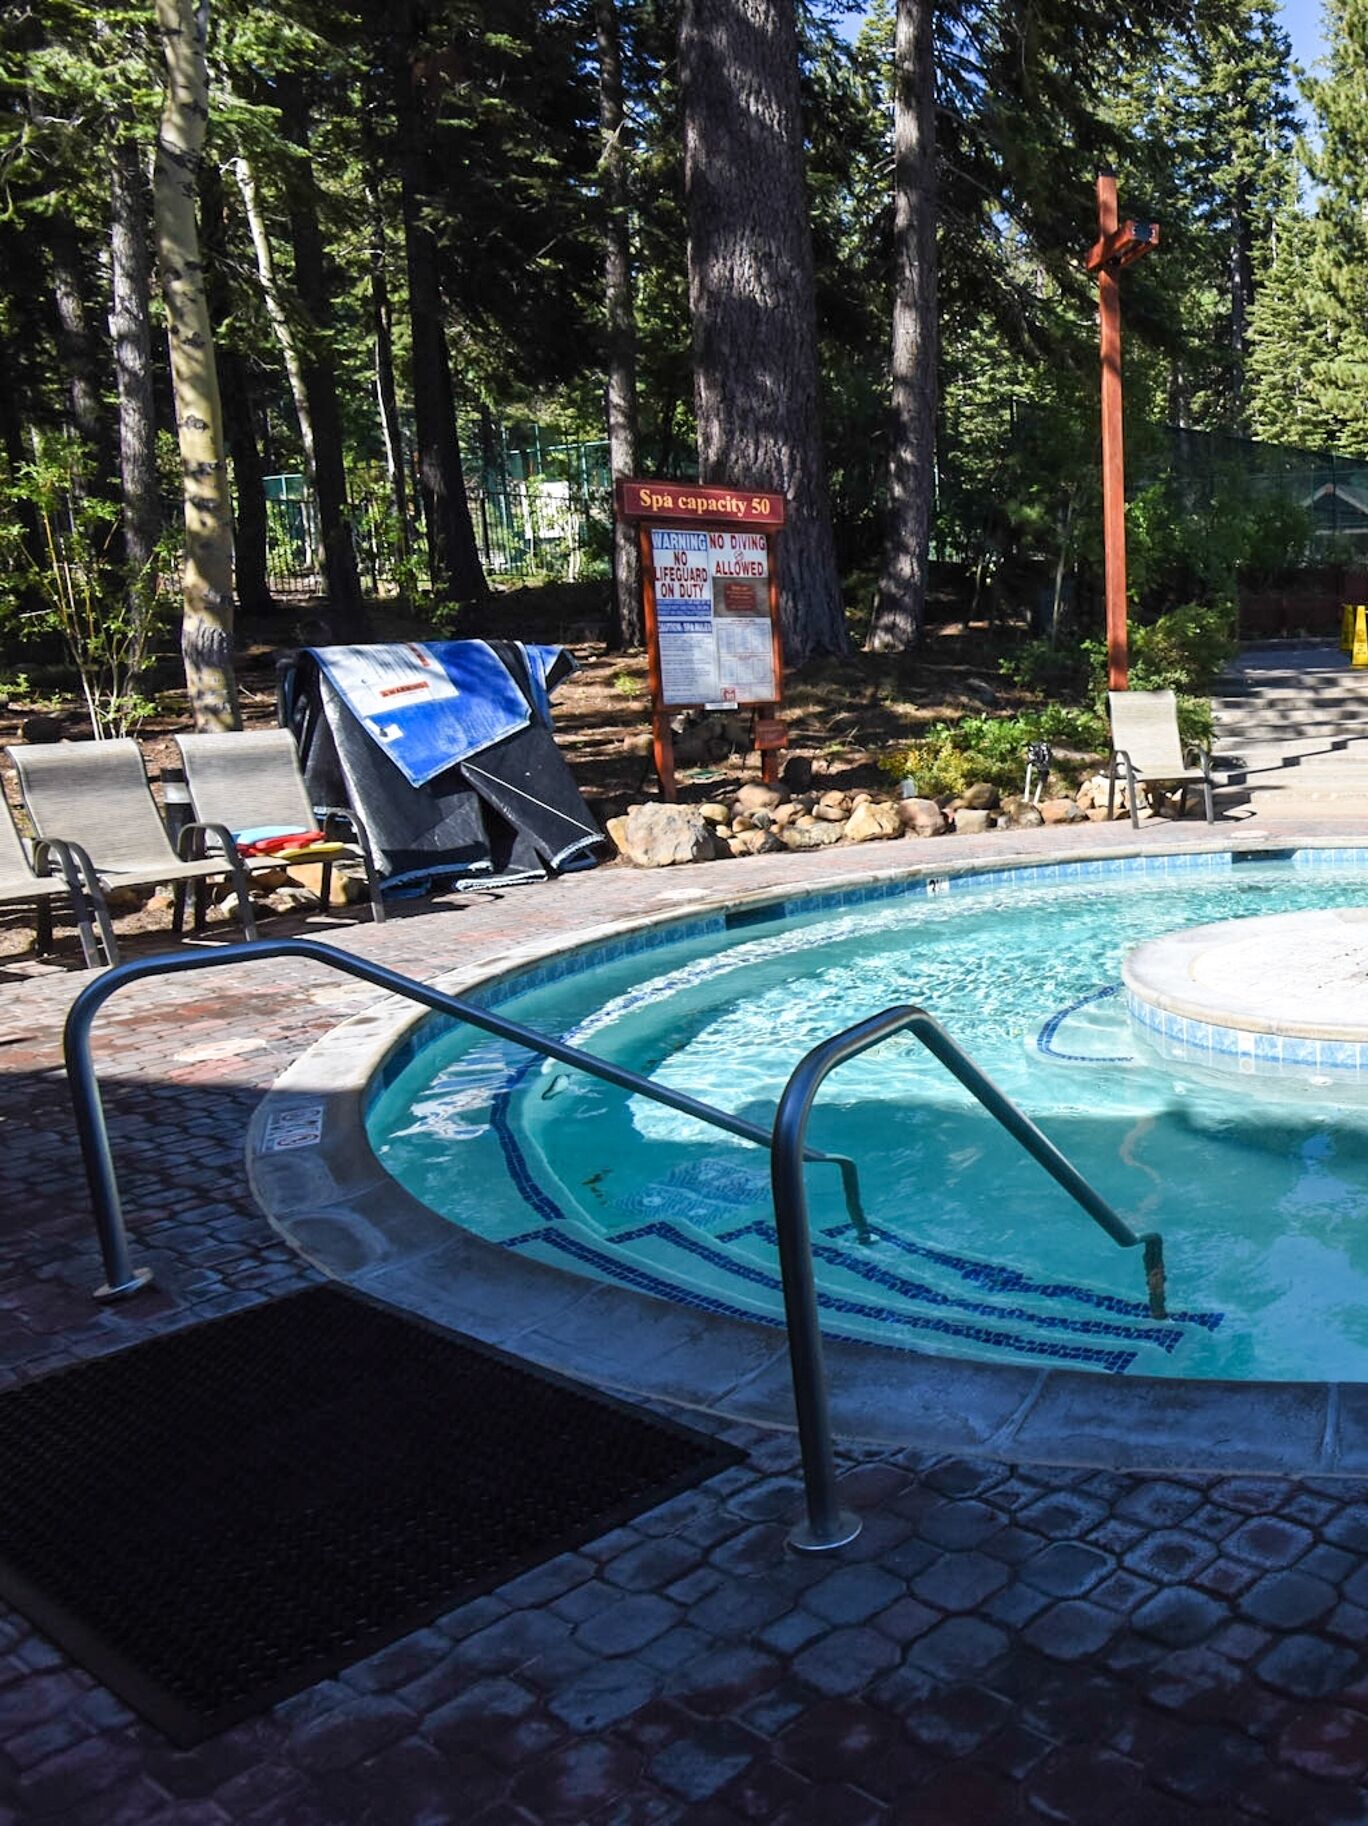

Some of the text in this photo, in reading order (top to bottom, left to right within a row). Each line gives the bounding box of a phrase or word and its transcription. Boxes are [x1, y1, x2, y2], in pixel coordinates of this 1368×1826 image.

[640, 489, 770, 517] Spa capacity 50
[652, 532, 706, 550] WARNING
[709, 533, 766, 551] NO DIVING
[674, 551, 687, 565] NO
[655, 567, 708, 582] LIFEGUARD
[715, 561, 764, 576] ALLOWED
[661, 583, 704, 598] ON DUTY
